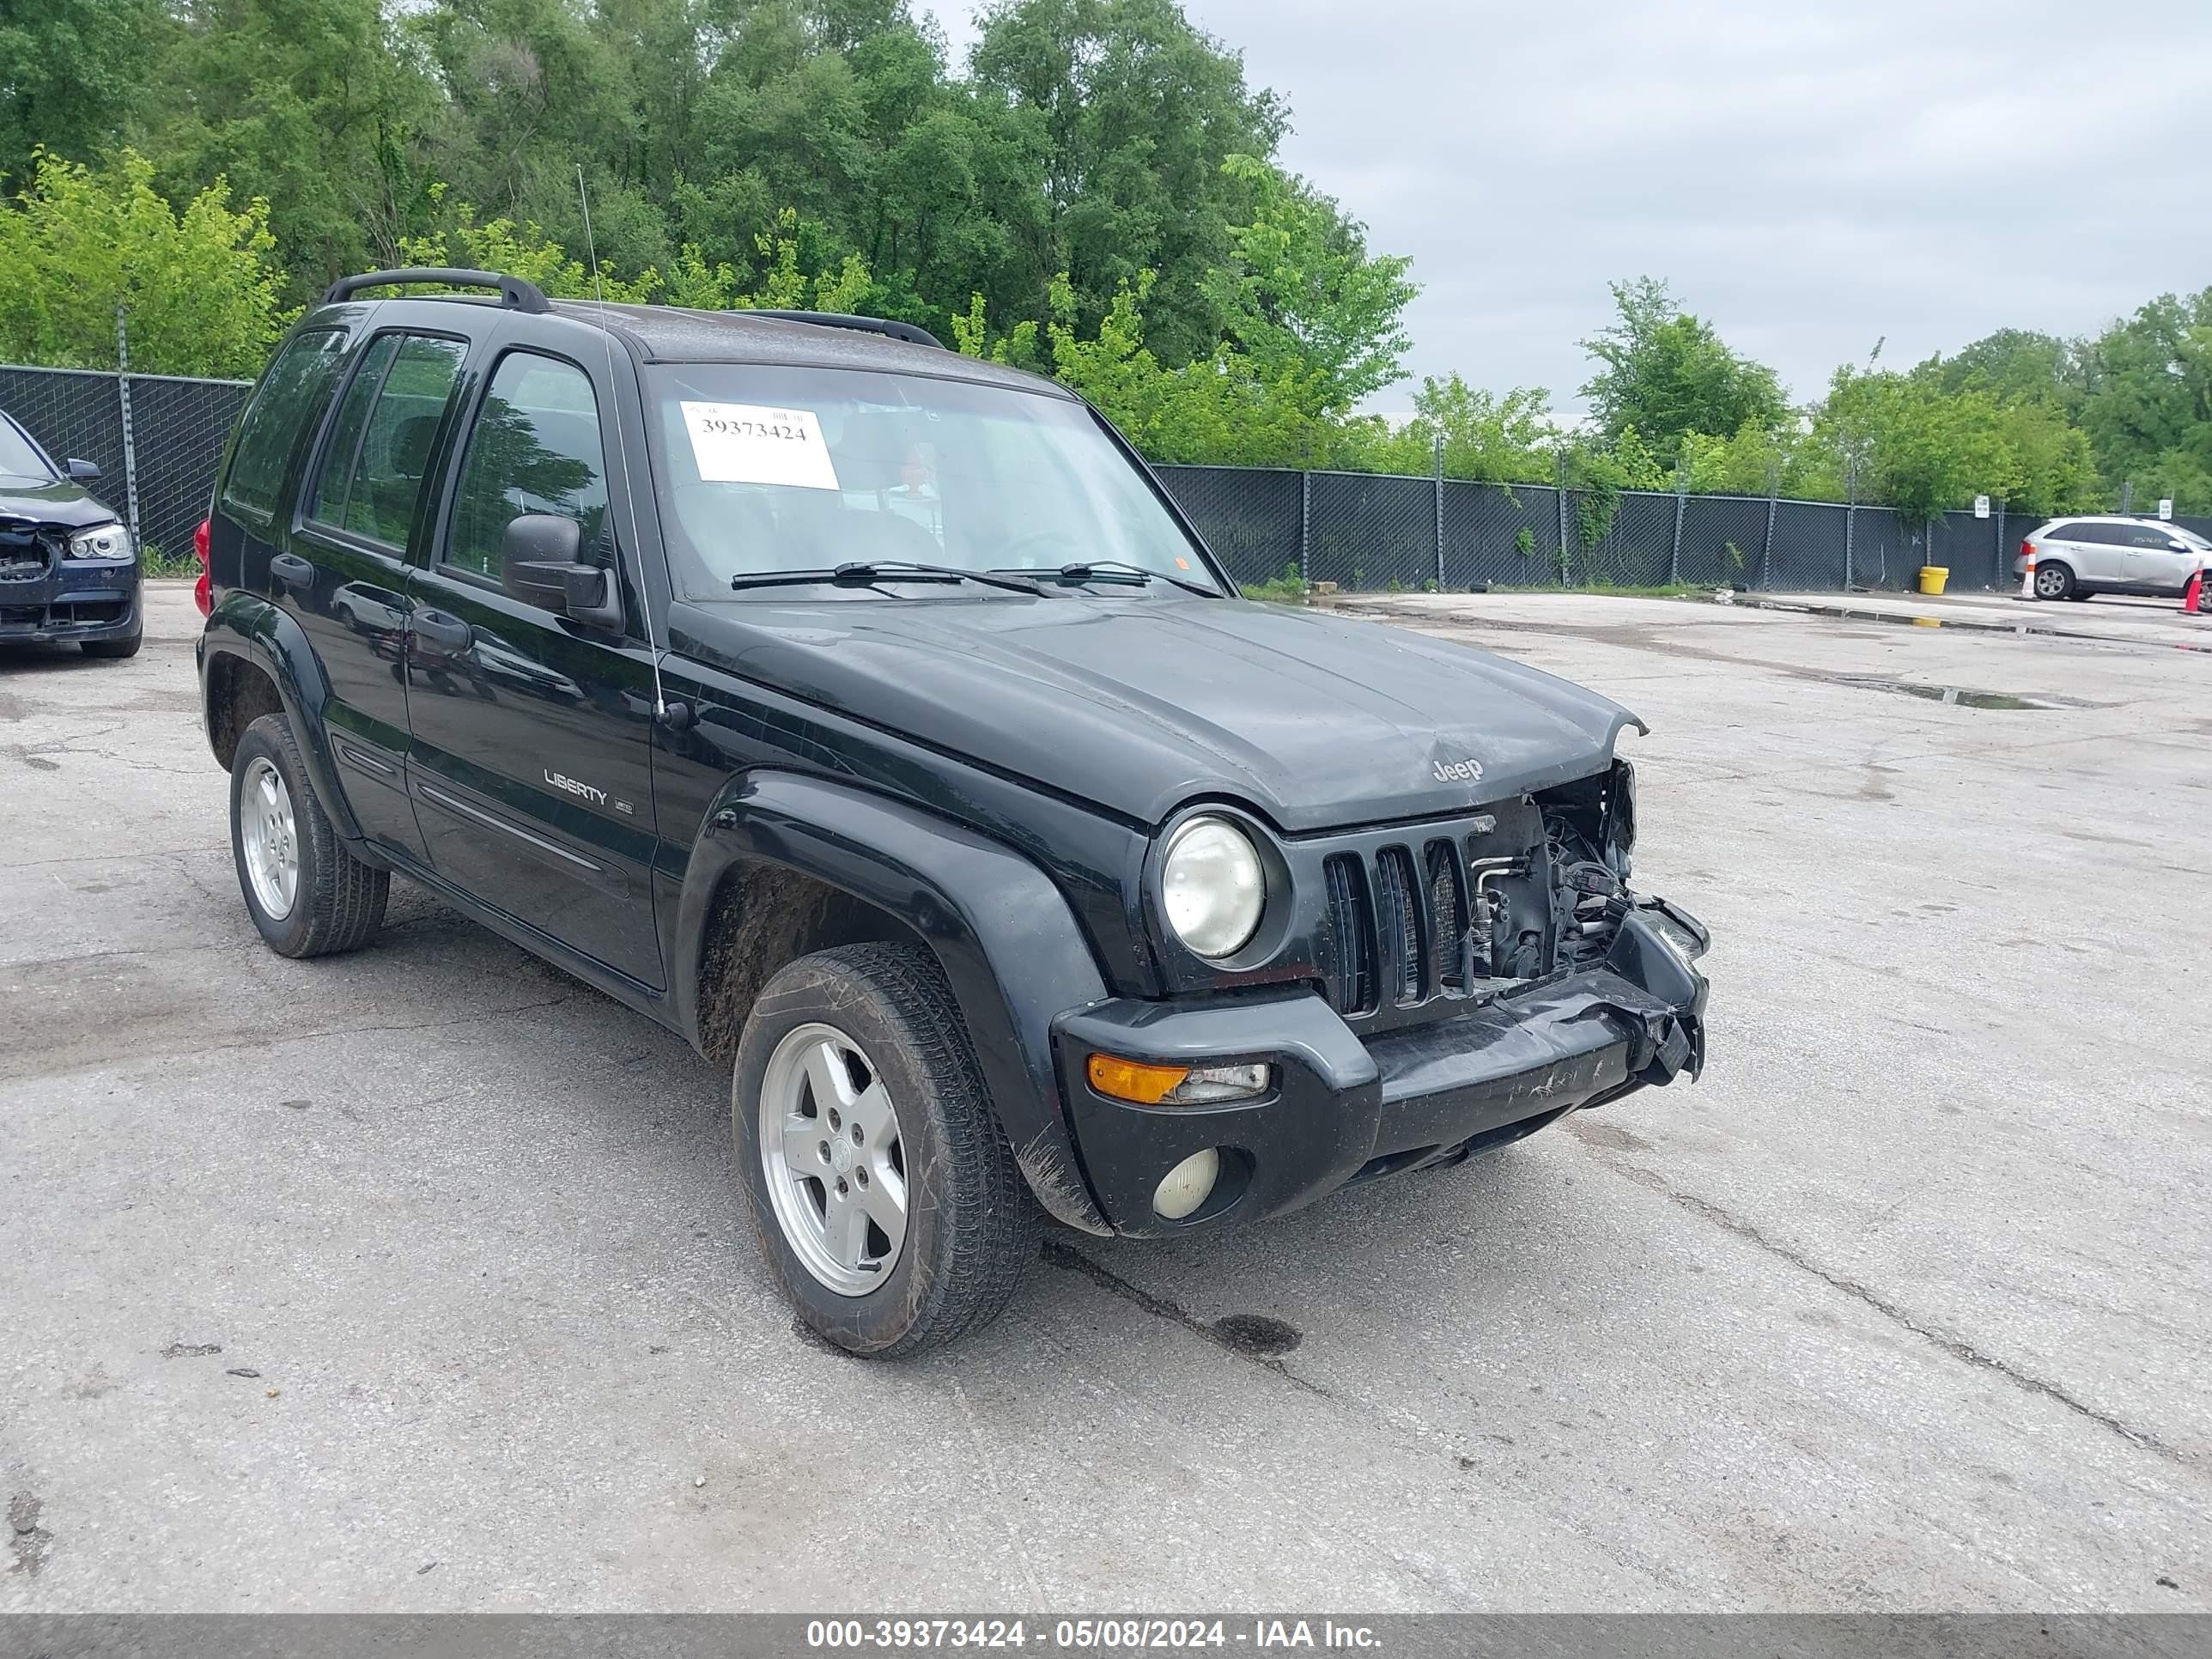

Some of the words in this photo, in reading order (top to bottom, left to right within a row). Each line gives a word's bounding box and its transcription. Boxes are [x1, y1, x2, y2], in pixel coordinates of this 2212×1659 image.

[702, 418, 807, 441] 39373424
[1432, 758, 1484, 783] Jeep
[544, 769, 607, 805] LIBERTY
